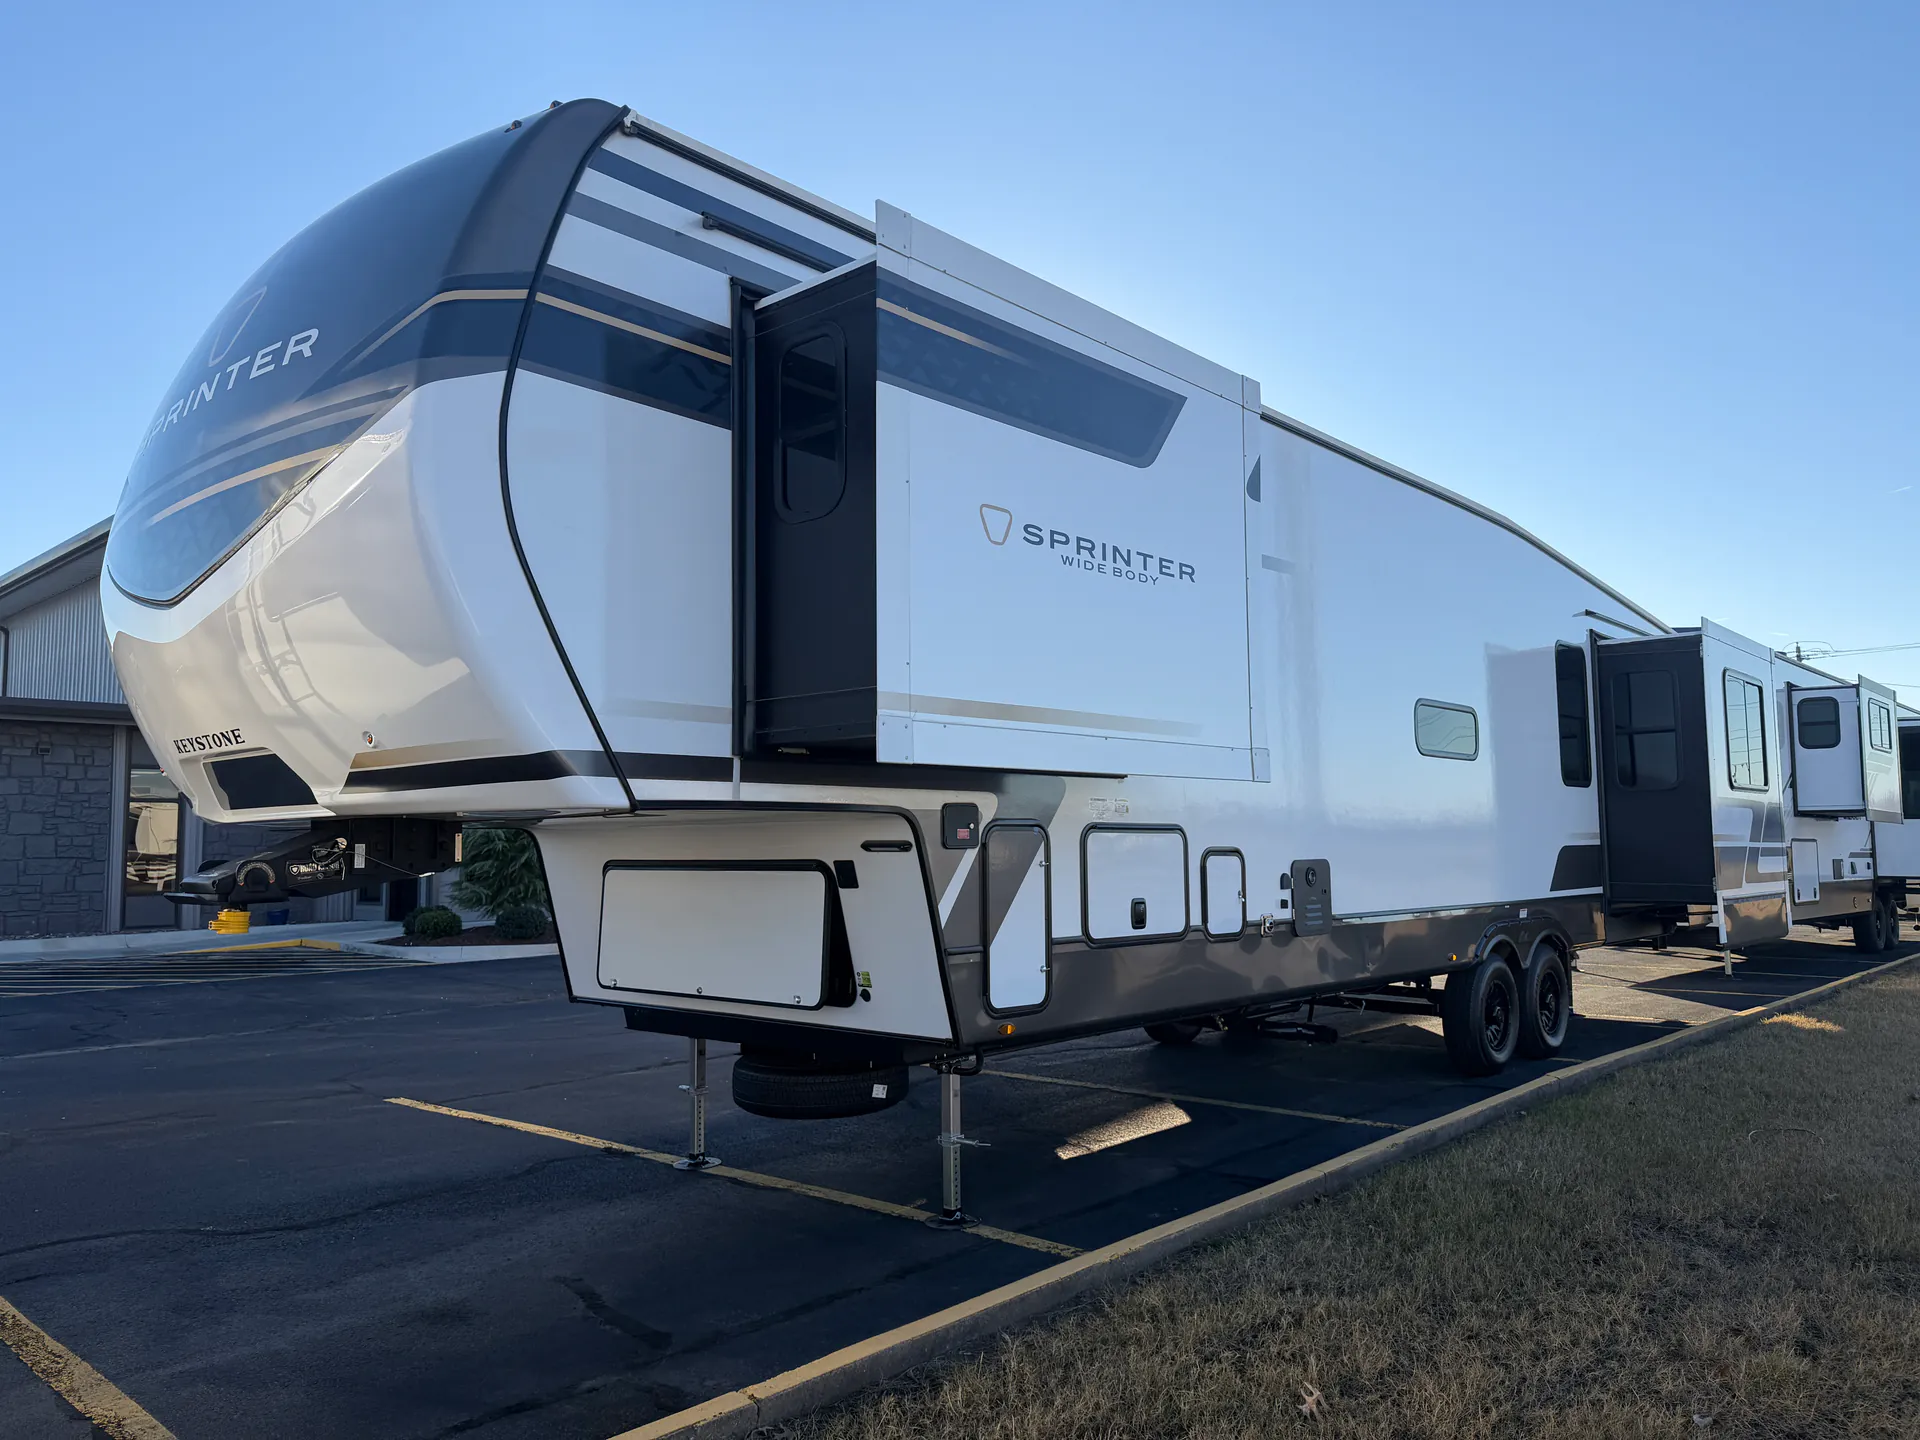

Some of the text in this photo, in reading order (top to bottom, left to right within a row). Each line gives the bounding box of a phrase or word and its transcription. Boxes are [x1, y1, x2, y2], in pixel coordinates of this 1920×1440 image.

[1022, 523, 1196, 583] SPRINTER
[1061, 554, 1159, 586] WIDE BODY
[173, 728, 246, 754] KEYSTONE
